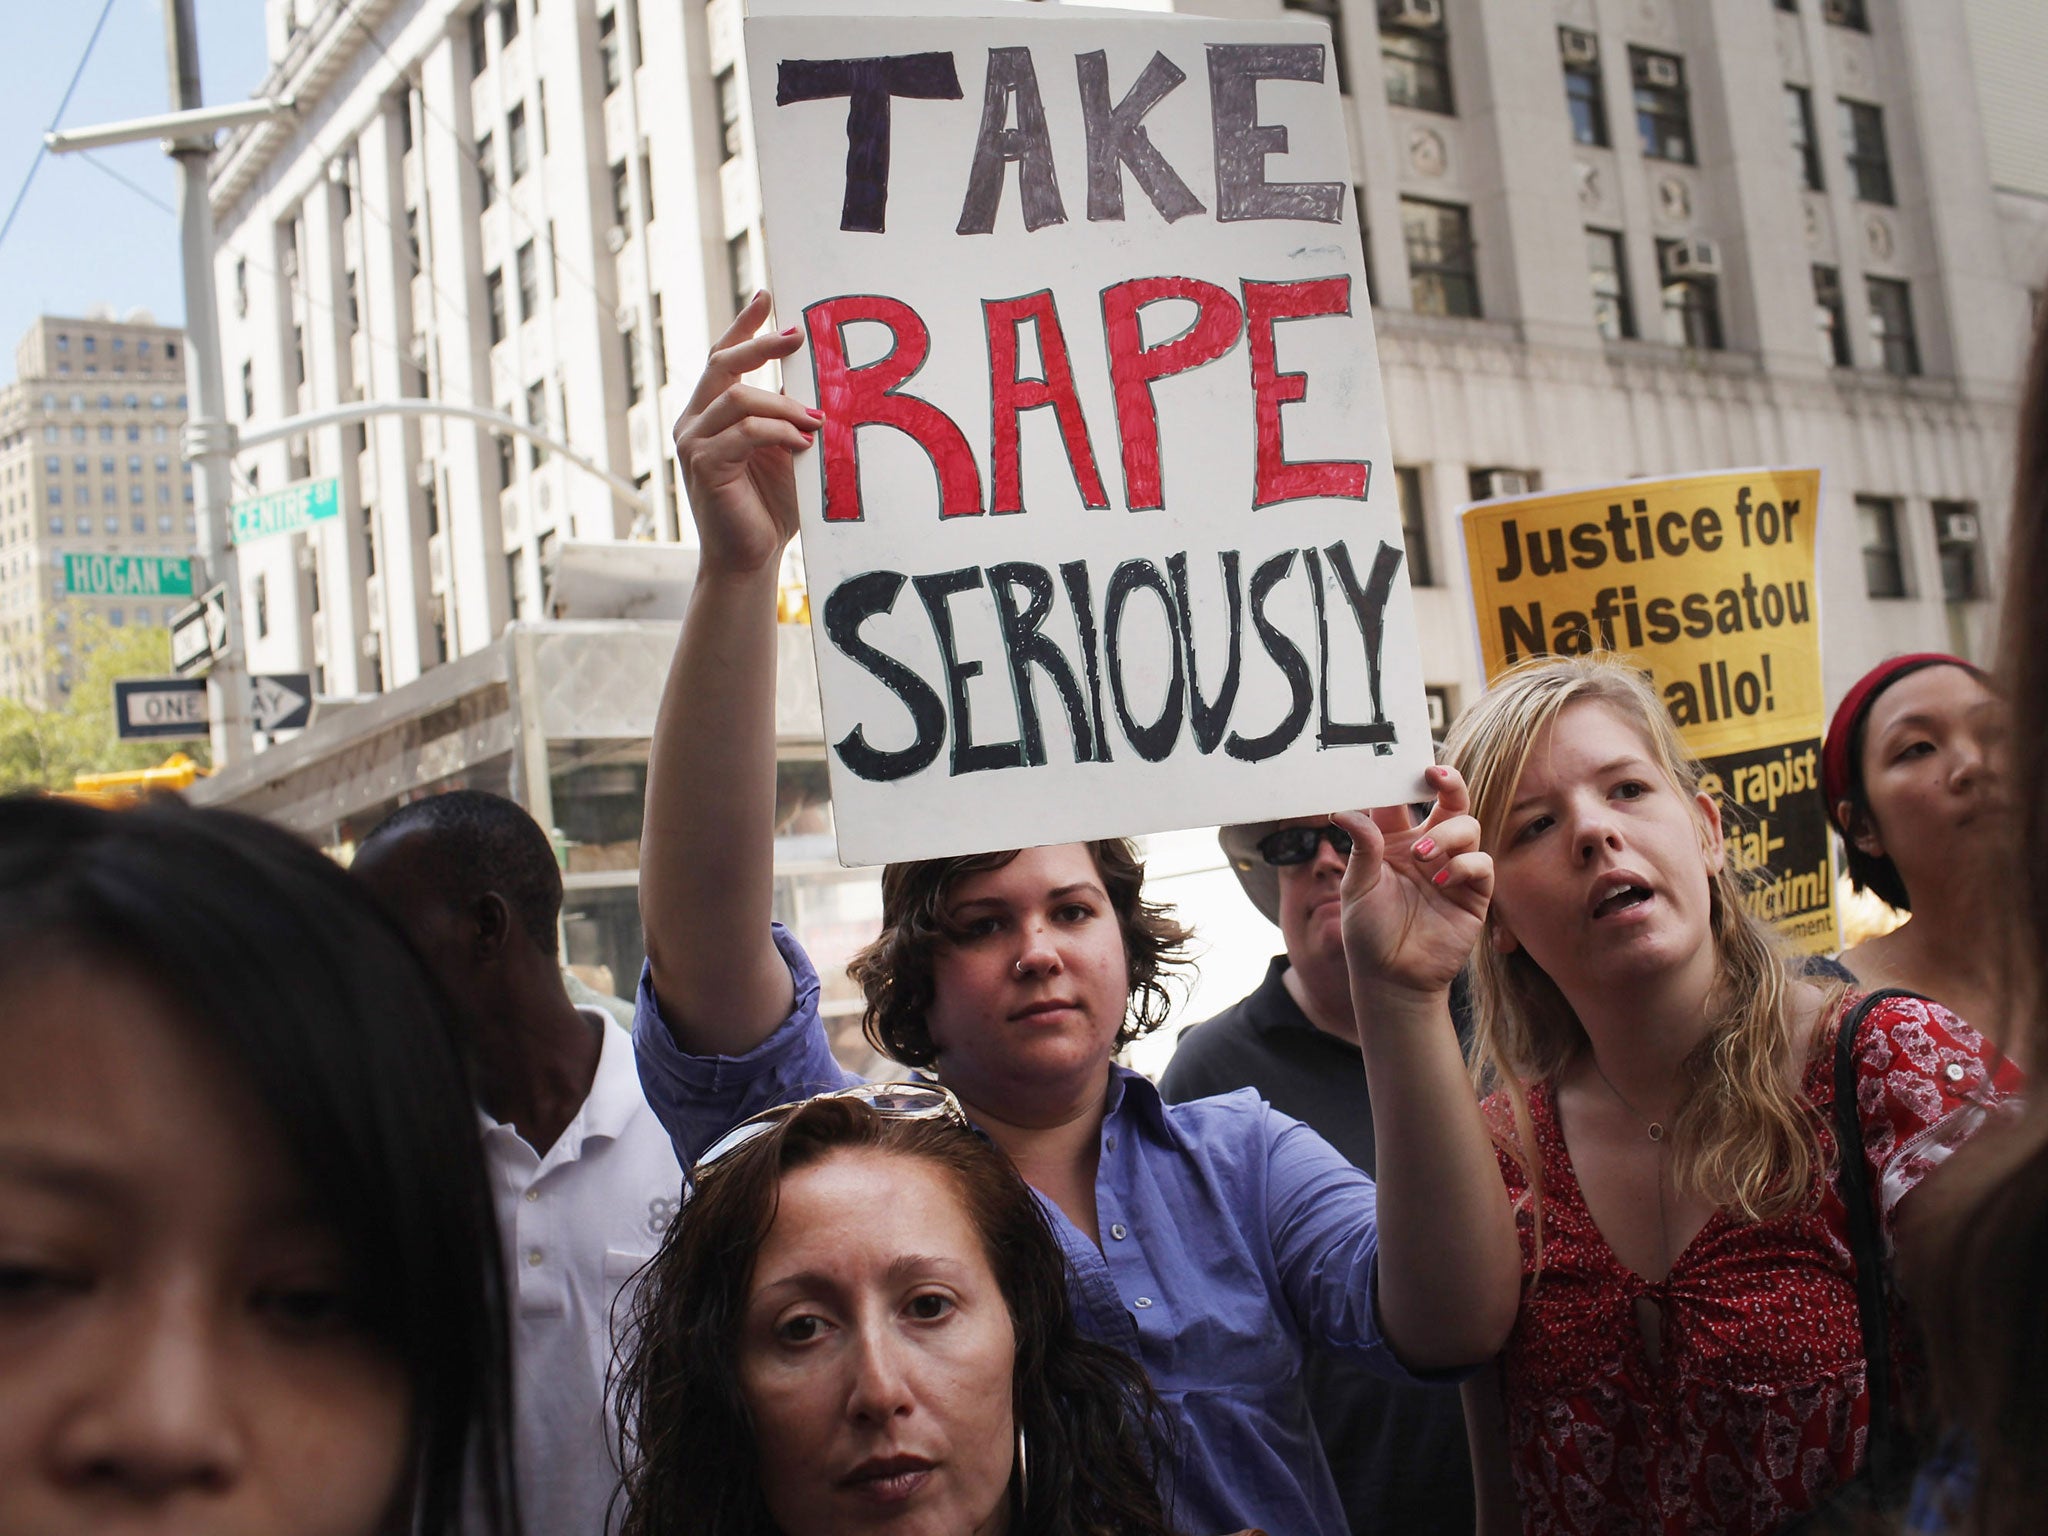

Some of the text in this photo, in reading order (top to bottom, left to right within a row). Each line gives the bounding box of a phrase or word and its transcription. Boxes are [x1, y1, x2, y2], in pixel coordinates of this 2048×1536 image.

[775, 43, 1346, 235] TAKE
[802, 273, 1371, 522] RAPE
[234, 486, 311, 541] CENTRE
[1496, 487, 1801, 582] Justice for
[71, 556, 188, 594] HOGAN PL
[1498, 572, 1810, 665] Nafissatou
[823, 539, 1404, 783] SERIOUSLY
[1640, 653, 1776, 728] allo!
[144, 690, 284, 722] ONE AY
[1733, 748, 1818, 813] rapist
